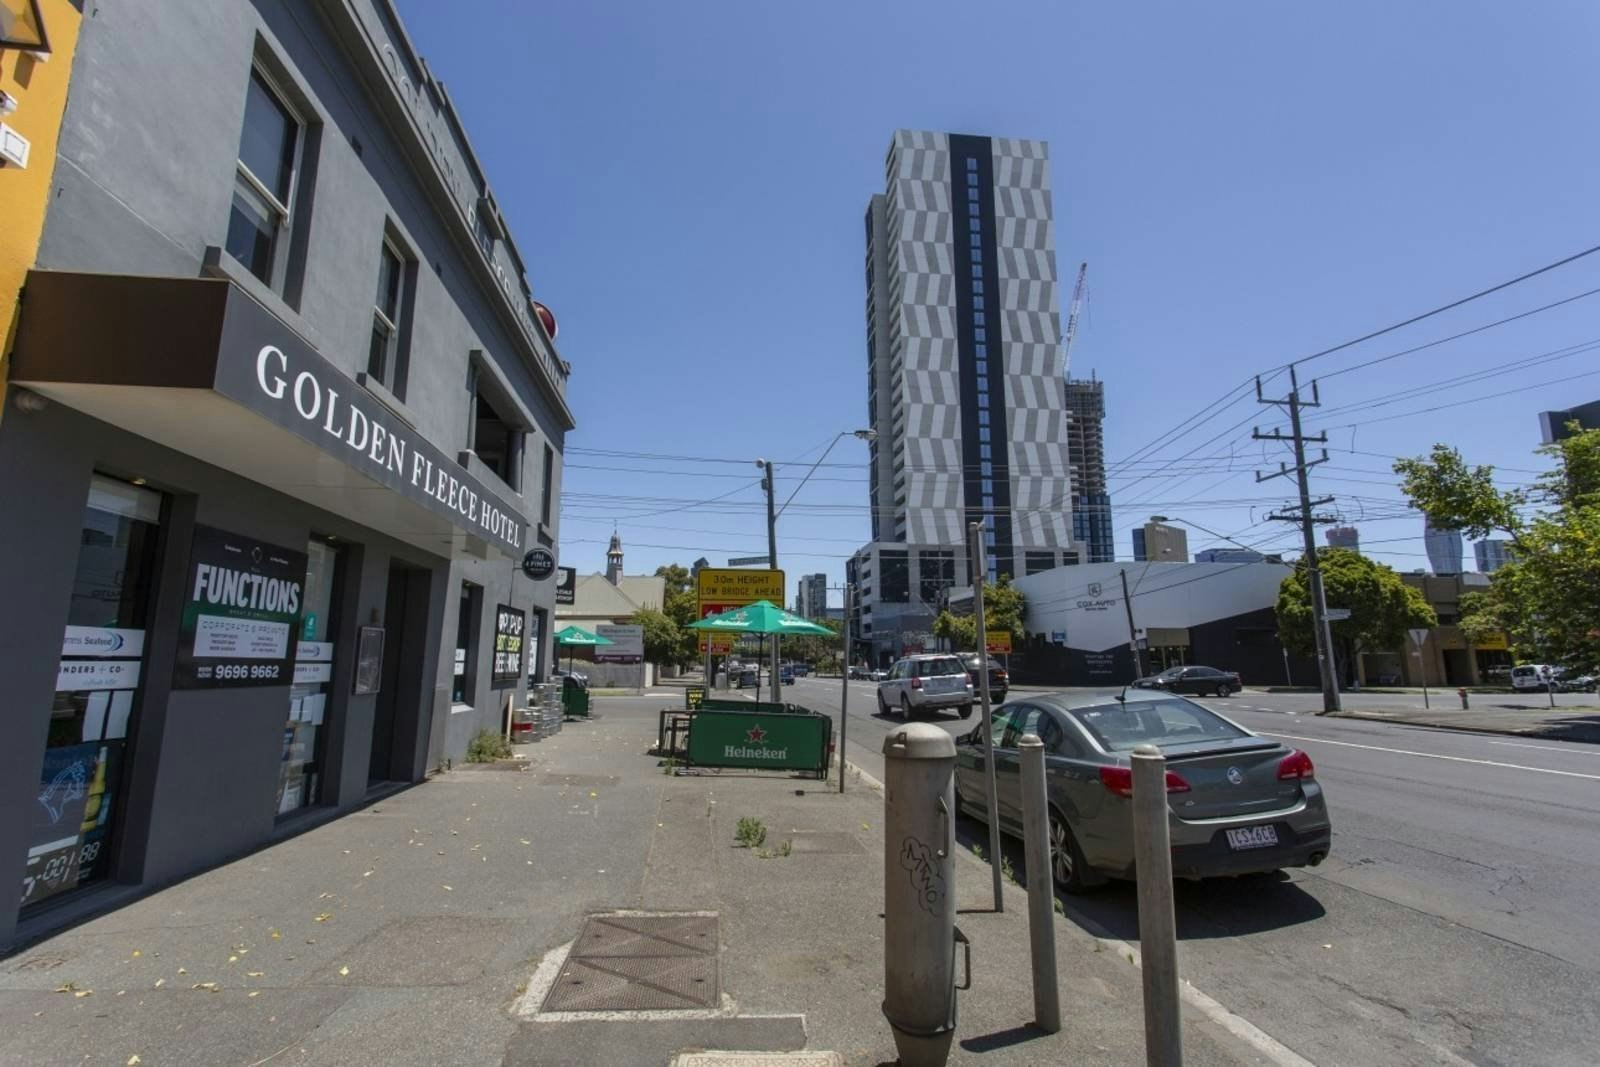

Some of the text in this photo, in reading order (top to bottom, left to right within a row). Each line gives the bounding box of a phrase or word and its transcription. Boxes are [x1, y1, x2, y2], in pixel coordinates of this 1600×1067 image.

[257, 345, 521, 549] GOLDEN FLEECE HOTEL
[737, 576, 770, 584] HEIGHT
[193, 563, 300, 615] FUNCTIONS
[721, 587, 750, 596] BRIDGE
[754, 587, 782, 596] AHEAD
[215, 665, 280, 679] 9696 9662
[724, 745, 788, 760] Heineken
